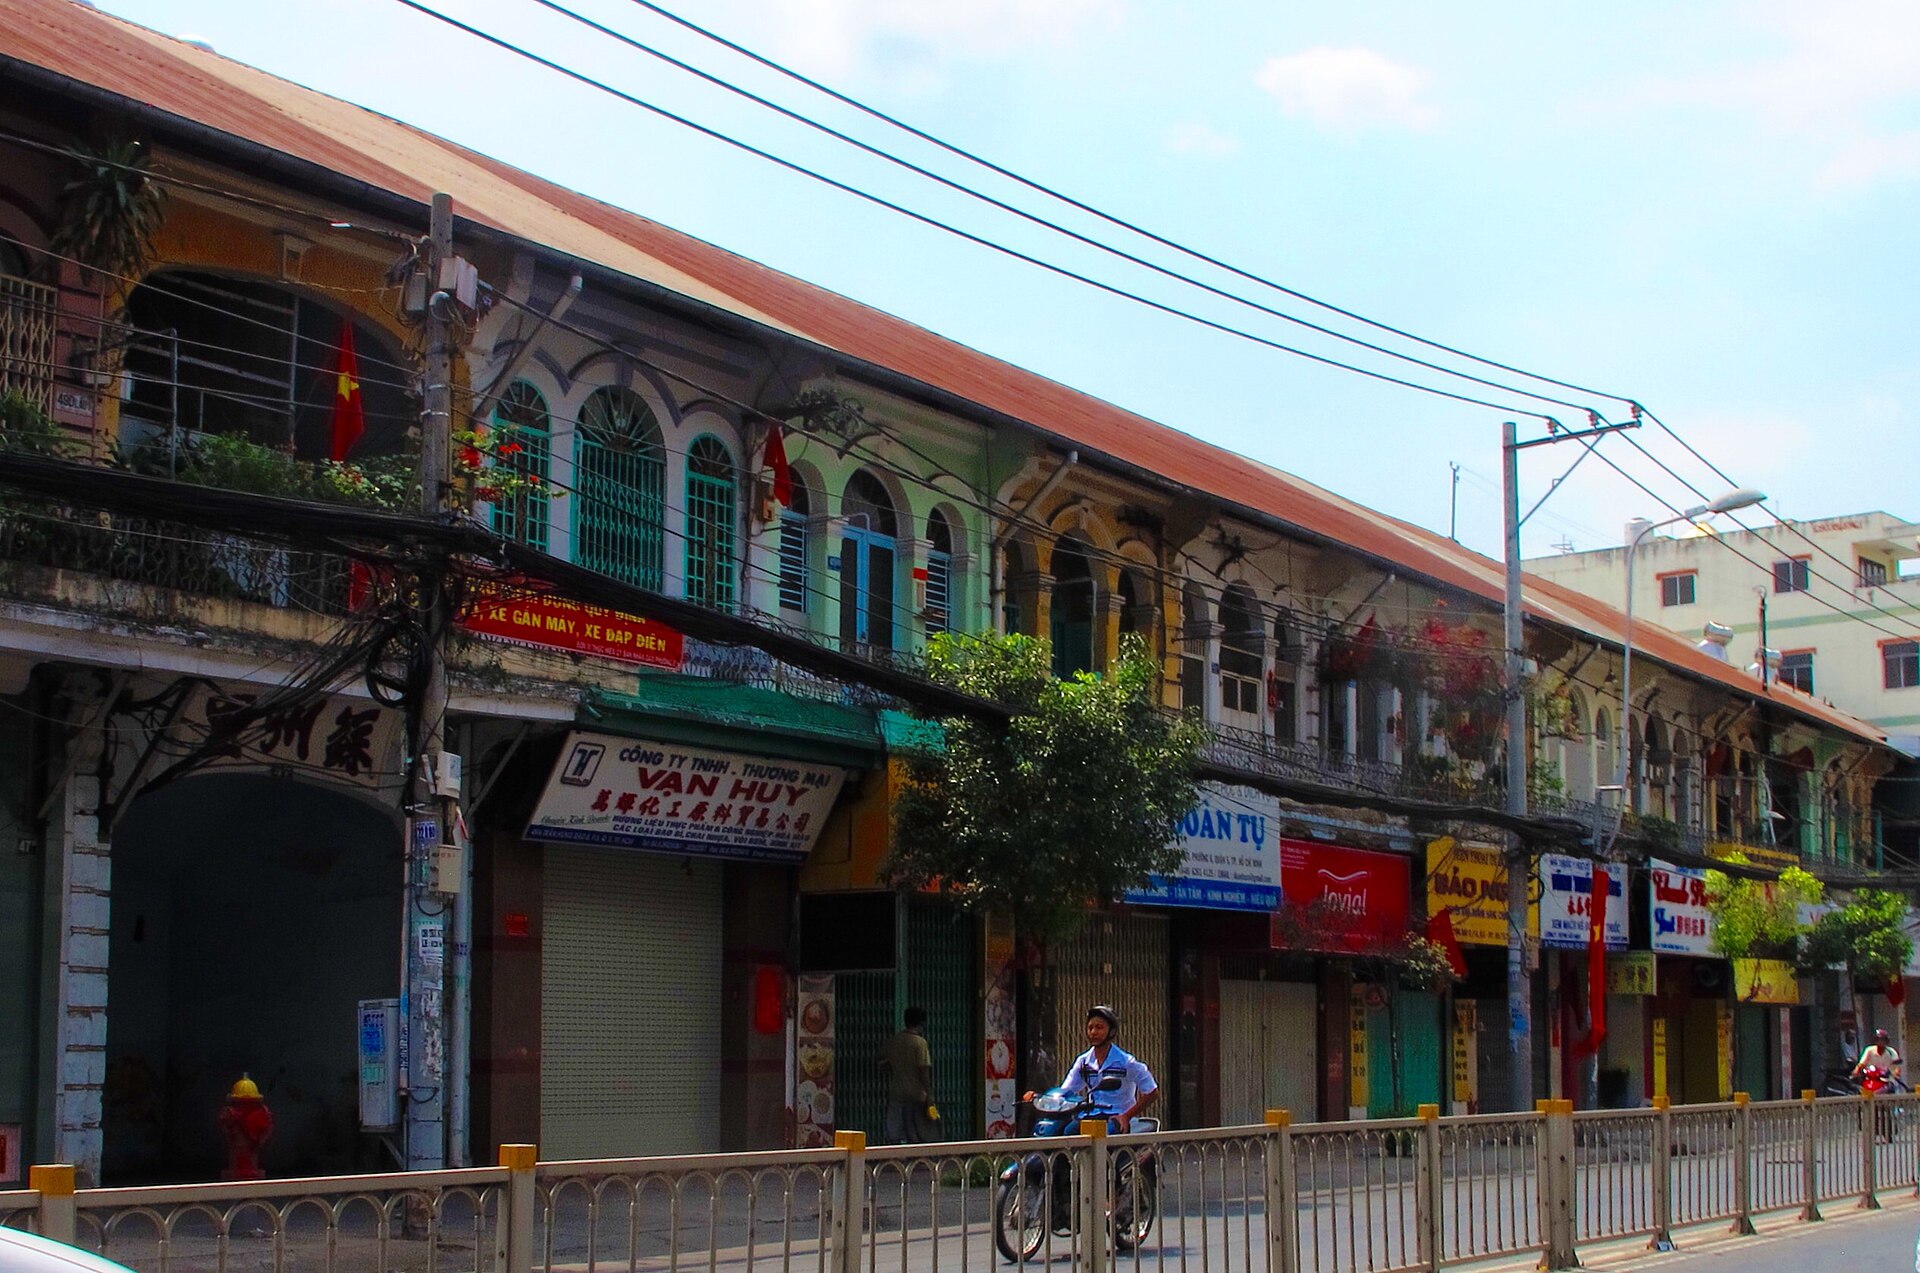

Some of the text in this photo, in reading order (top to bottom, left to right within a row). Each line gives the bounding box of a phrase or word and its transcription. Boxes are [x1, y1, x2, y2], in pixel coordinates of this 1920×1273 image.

[584, 623, 602, 640] XE
[619, 744, 664, 766] CÔNG
[668, 754, 688, 768] TY
[691, 757, 730, 774] TNHH
[802, 771, 831, 789] MẠI
[638, 766, 810, 807] VẠN HUY
[1237, 814, 1264, 851] TỤ
